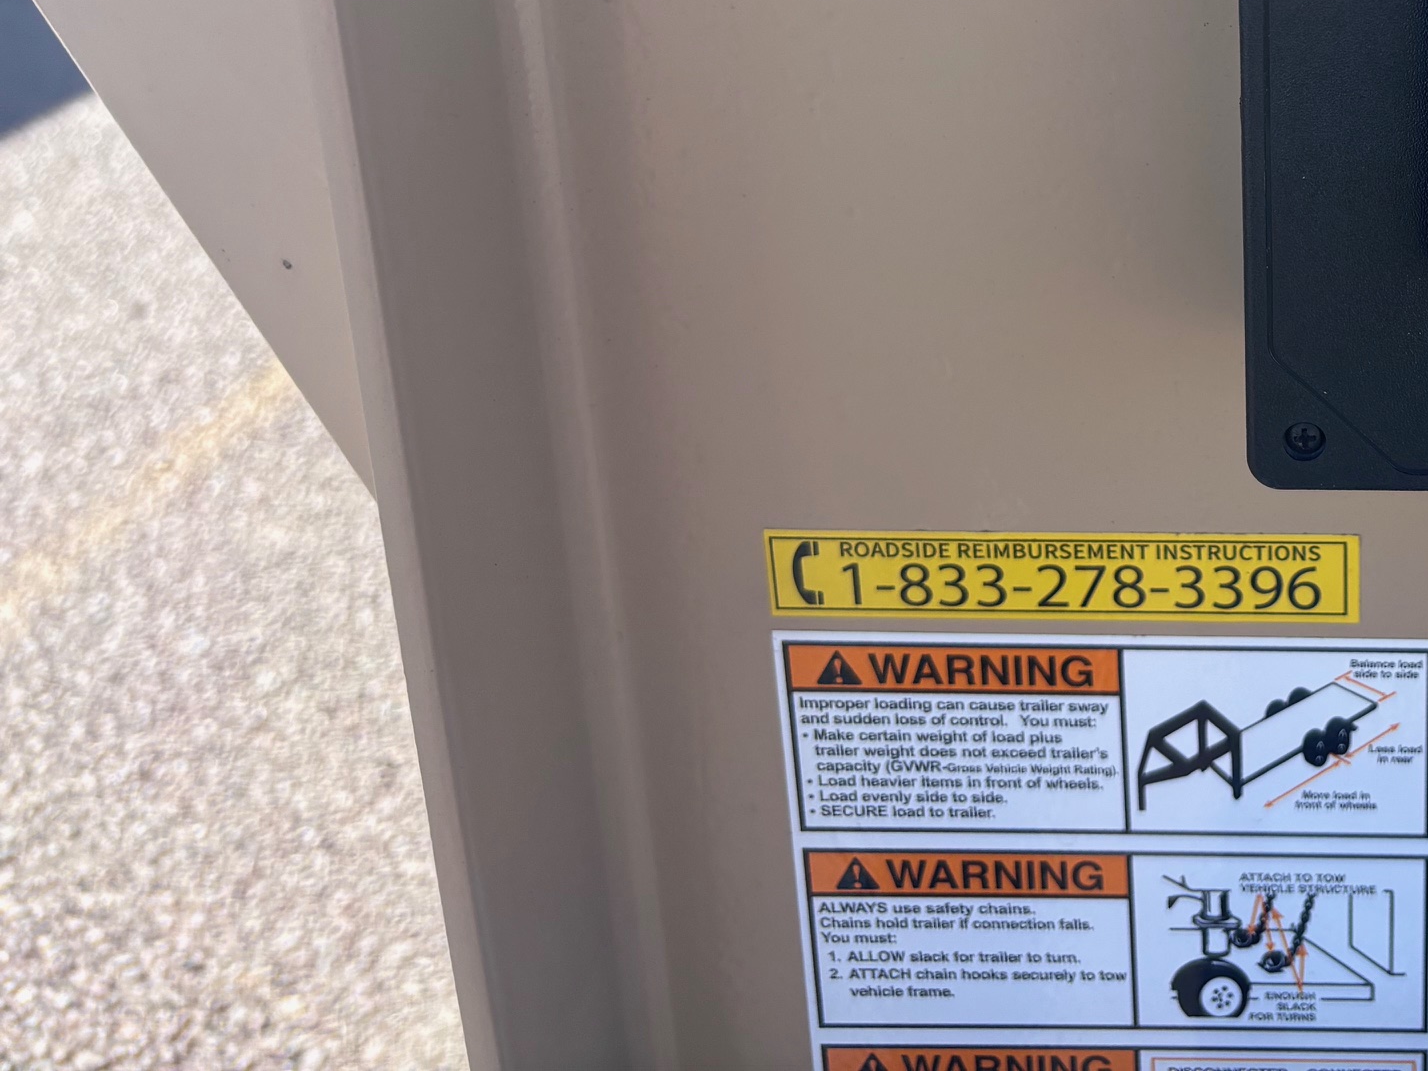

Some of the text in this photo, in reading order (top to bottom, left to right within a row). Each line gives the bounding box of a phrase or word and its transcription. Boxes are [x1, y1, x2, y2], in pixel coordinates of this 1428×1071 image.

[839, 541, 1322, 563] ROADSIDE REIMBURSEMENT INSTRUCTIONS
[841, 563, 1323, 610] 1-833-278-3396
[868, 653, 1094, 687] WARNING
[800, 697, 1109, 715] Improper loading can cause trailer sway
[801, 713, 1096, 727] and sudden loss of control. You must:
[814, 729, 1062, 745] Make certain weight of load plus
[816, 745, 1108, 759] trailer weight does not exceed trailer's
[817, 761, 880, 773] capacity
[986, 764, 1027, 773] Vehicle
[1031, 765, 1070, 776] Weight
[1075, 766, 1118, 777] Rating).
[818, 776, 1103, 790] Load heavier items in front of wheels.
[820, 791, 1008, 804] Load evenly side to side.
[821, 806, 995, 818] SECURE load to trailer.
[885, 859, 1104, 891] WARNING
[819, 902, 1036, 915] ALWAYS use safety chains.
[820, 917, 1094, 930] Chains hold trailer if connection fails.
[821, 932, 897, 944] You must:
[829, 951, 1081, 964] 1. ALLOW slack for trailer to turn.
[829, 968, 1127, 983] 2. ATTACH chain hooks securely to tow
[850, 986, 955, 997] vehicle frame.
